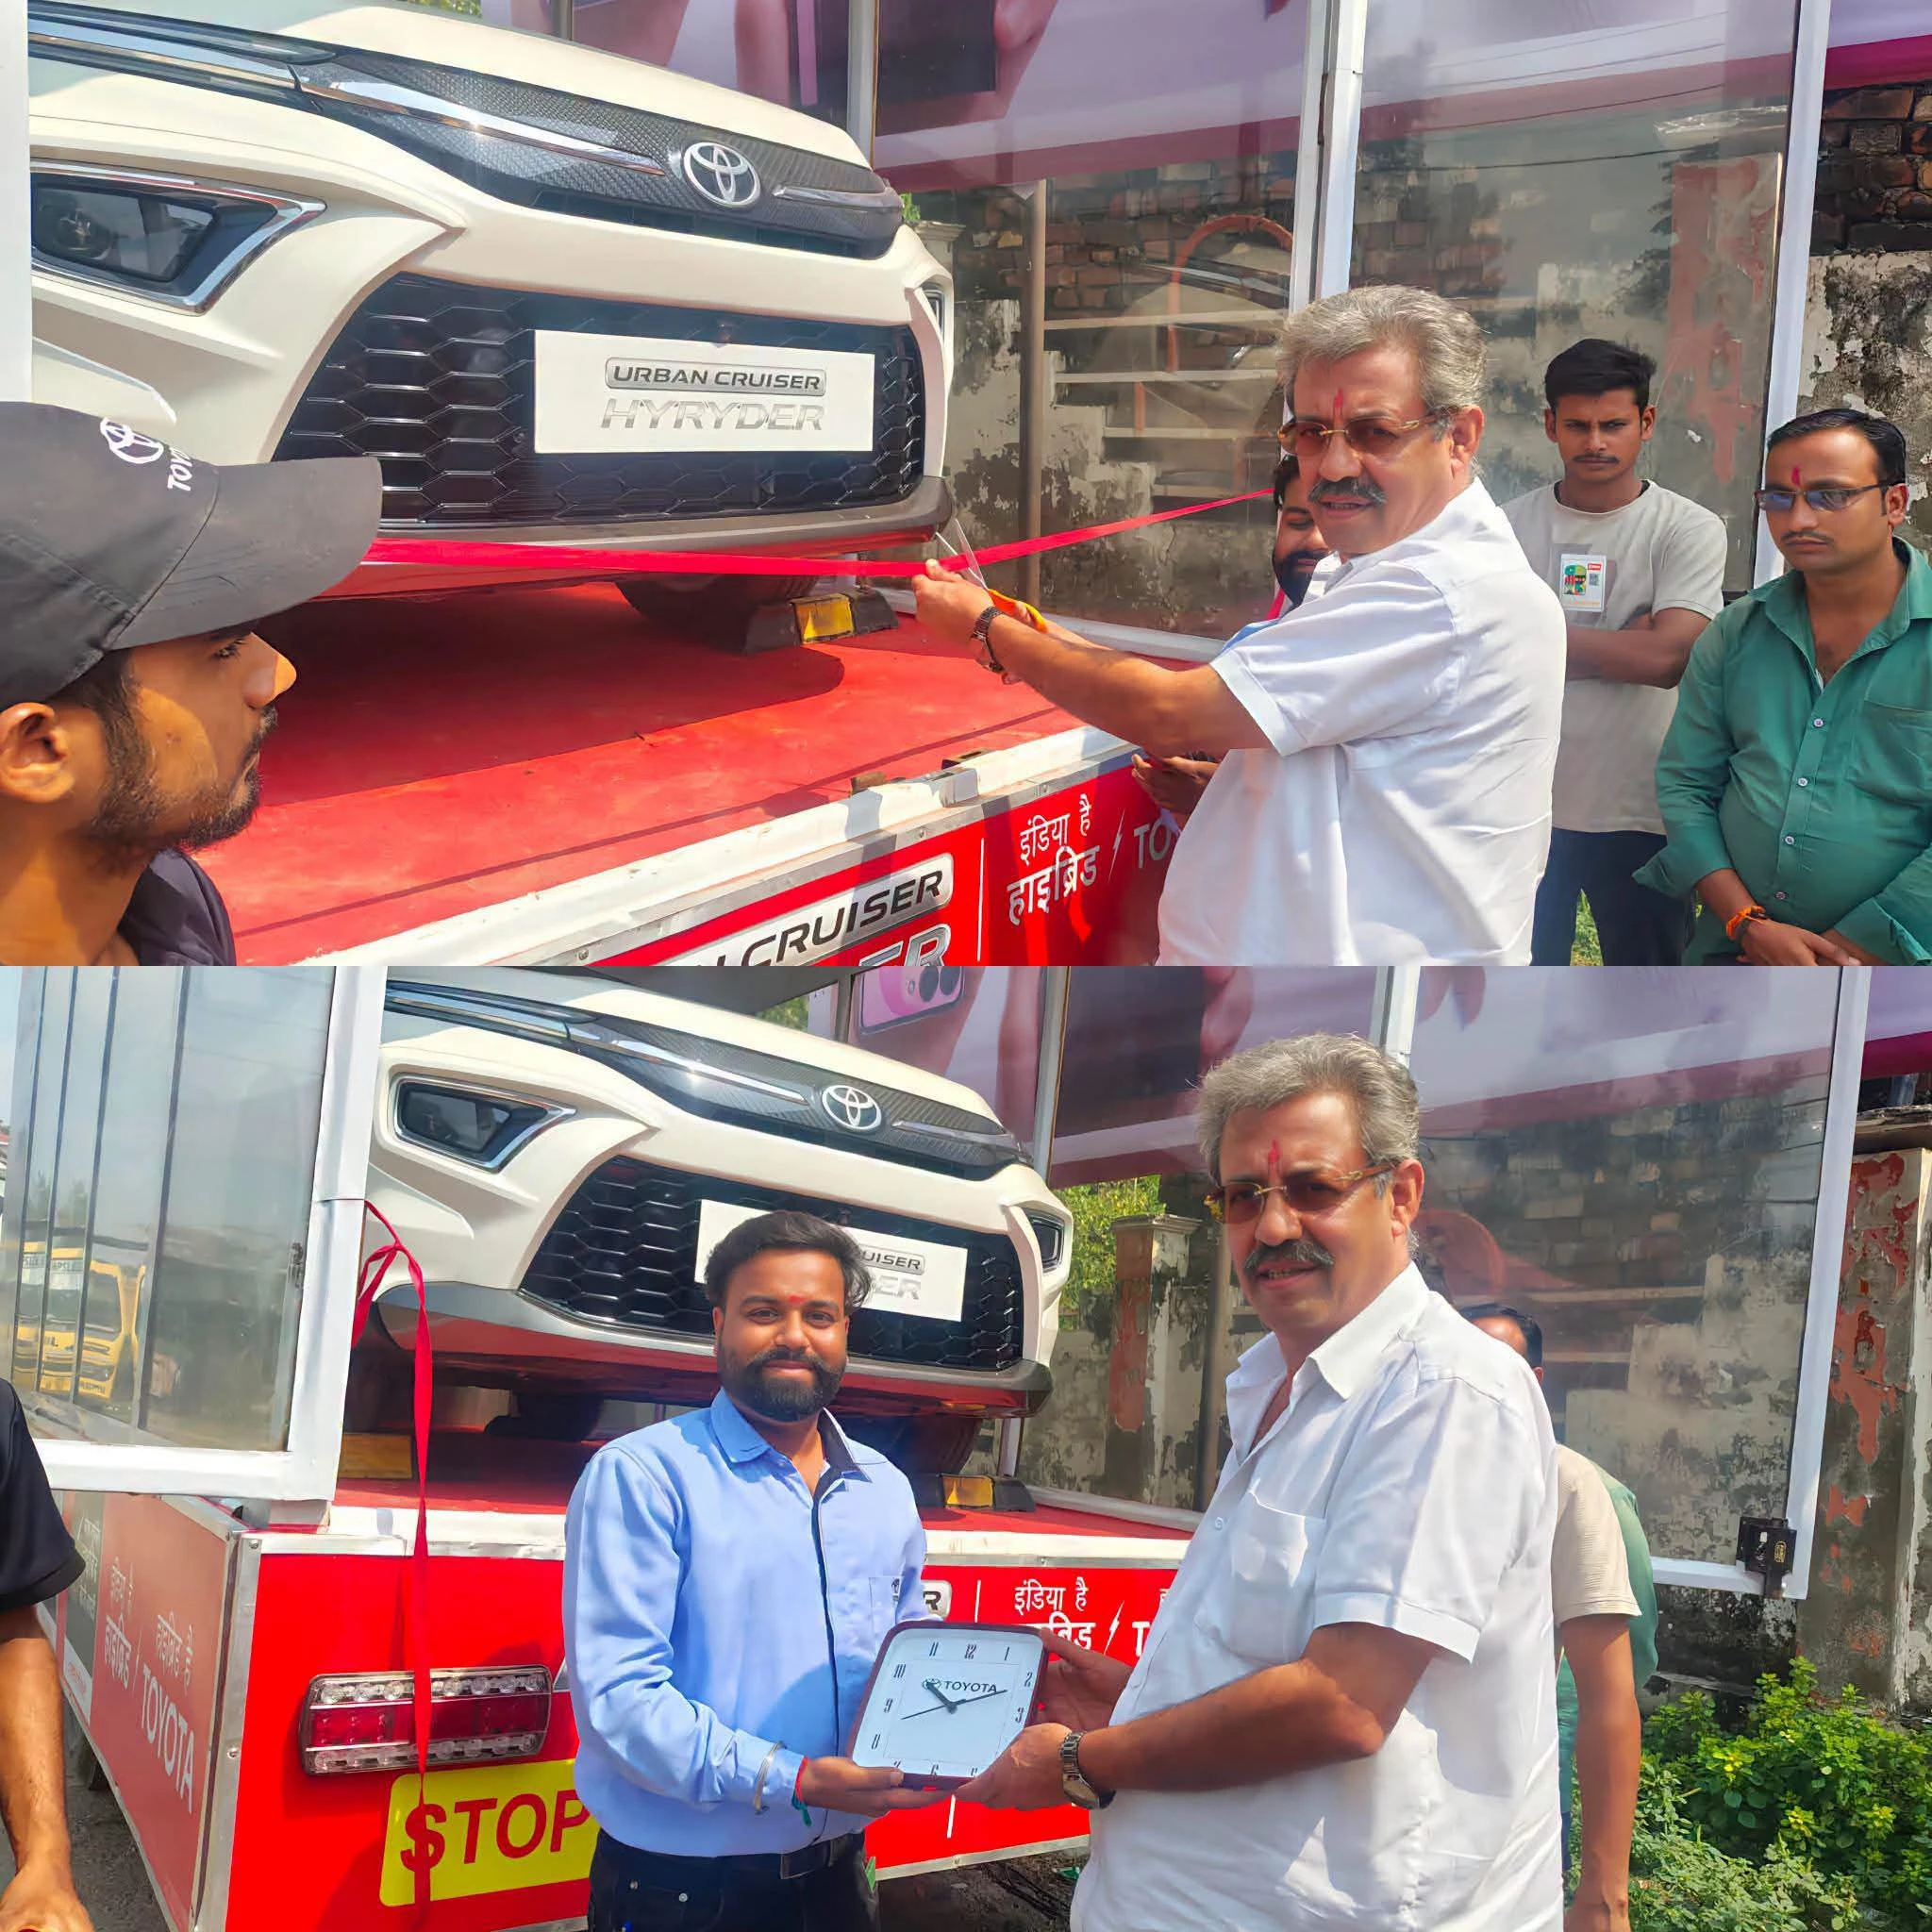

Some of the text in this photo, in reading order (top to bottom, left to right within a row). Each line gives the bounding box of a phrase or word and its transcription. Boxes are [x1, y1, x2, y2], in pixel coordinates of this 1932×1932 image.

[613, 365, 821, 390] URBAN CRUISER
[601, 397, 825, 431] HYRYDER
[1020, 793, 1092, 866] इंडिया है
[1007, 845, 1100, 925] हाइब्रिड
[741, 870, 943, 966] CRUISER
[1014, 1576, 1090, 1616] इंडिया है
[964, 1643, 977, 1659] 12
[944, 1680, 998, 1693] TOYOTA
[1024, 1671, 1033, 1688] 2
[883, 1698, 893, 1713] 9
[1015, 1707, 1024, 1724] 3
[142, 1663, 194, 1815] TOYOTA
[400, 1789, 591, 1872] STOP
